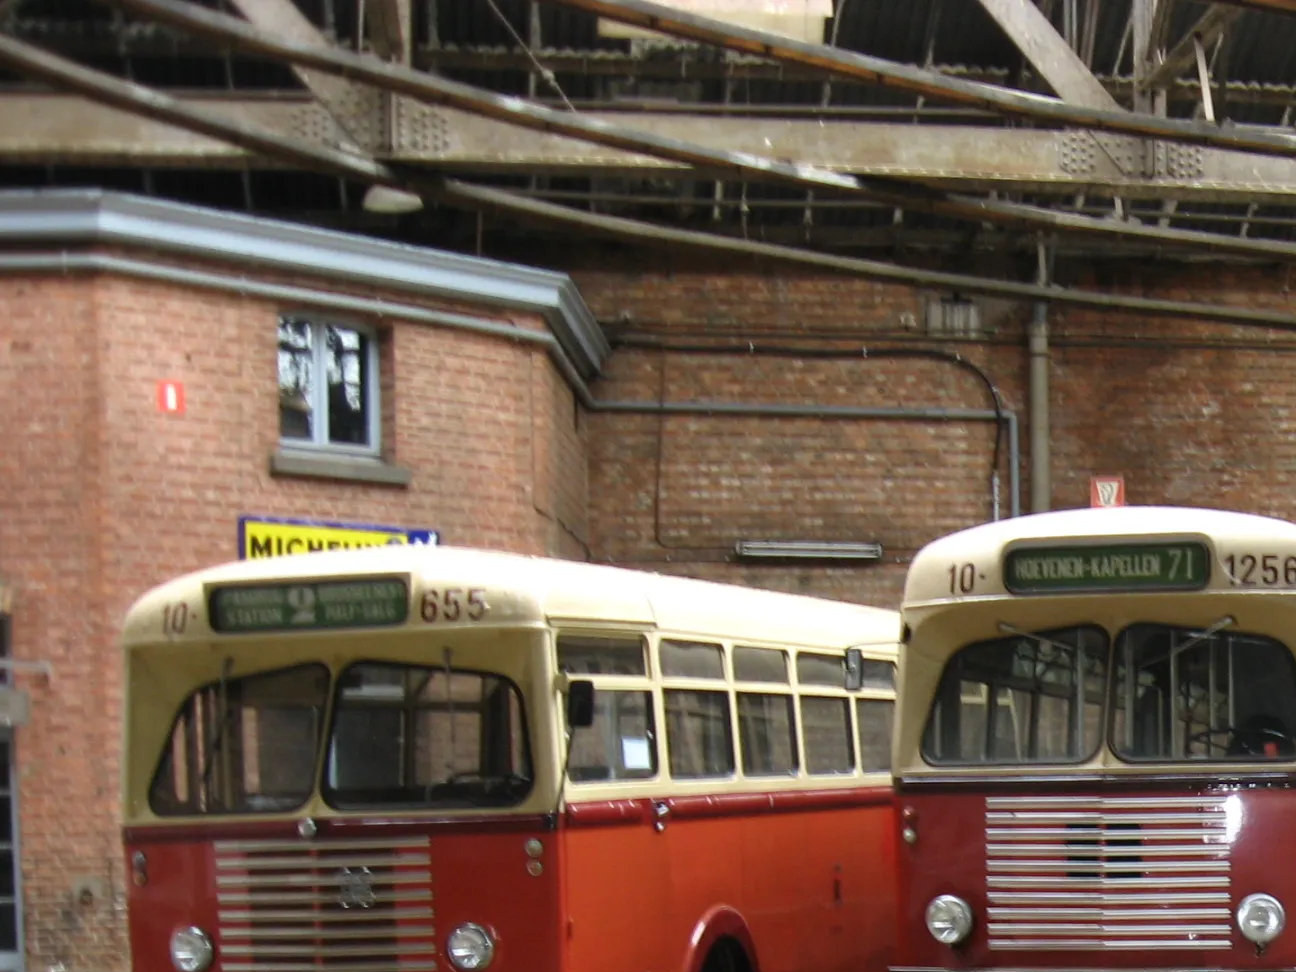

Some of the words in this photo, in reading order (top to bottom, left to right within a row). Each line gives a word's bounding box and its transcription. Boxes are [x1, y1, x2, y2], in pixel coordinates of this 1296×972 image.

[250, 535, 382, 559] MICH
[1168, 547, 1193, 580] 71
[421, 588, 487, 623] 655
